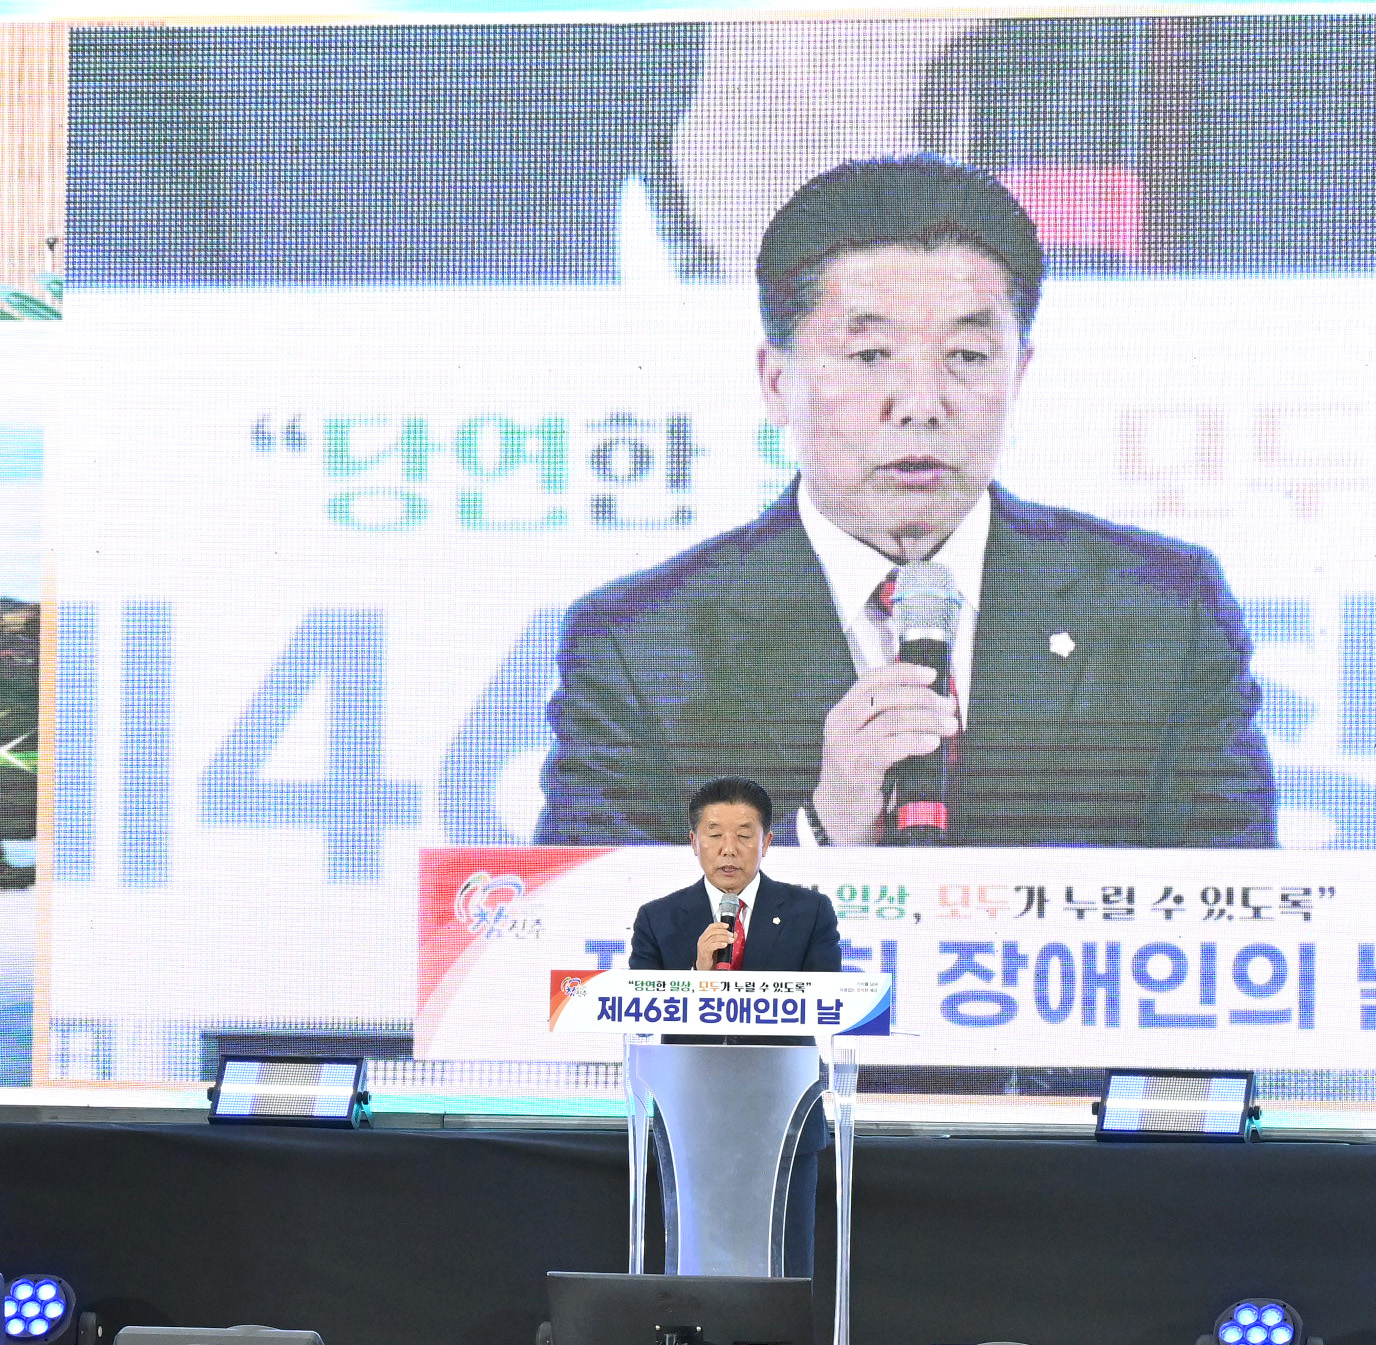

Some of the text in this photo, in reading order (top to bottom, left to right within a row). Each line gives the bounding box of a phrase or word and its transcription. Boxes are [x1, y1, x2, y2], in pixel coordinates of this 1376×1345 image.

[937, 884, 1049, 921] 모두가
[1063, 884, 1136, 921] 누릴
[1151, 884, 1188, 921] 수
[699, 980, 731, 993] 모두가
[734, 981, 756, 993] 누릴
[758, 981, 770, 993] 수
[937, 939, 1317, 1030] 장애인의
[597, 996, 843, 1026] 제46회 장애인의 날
